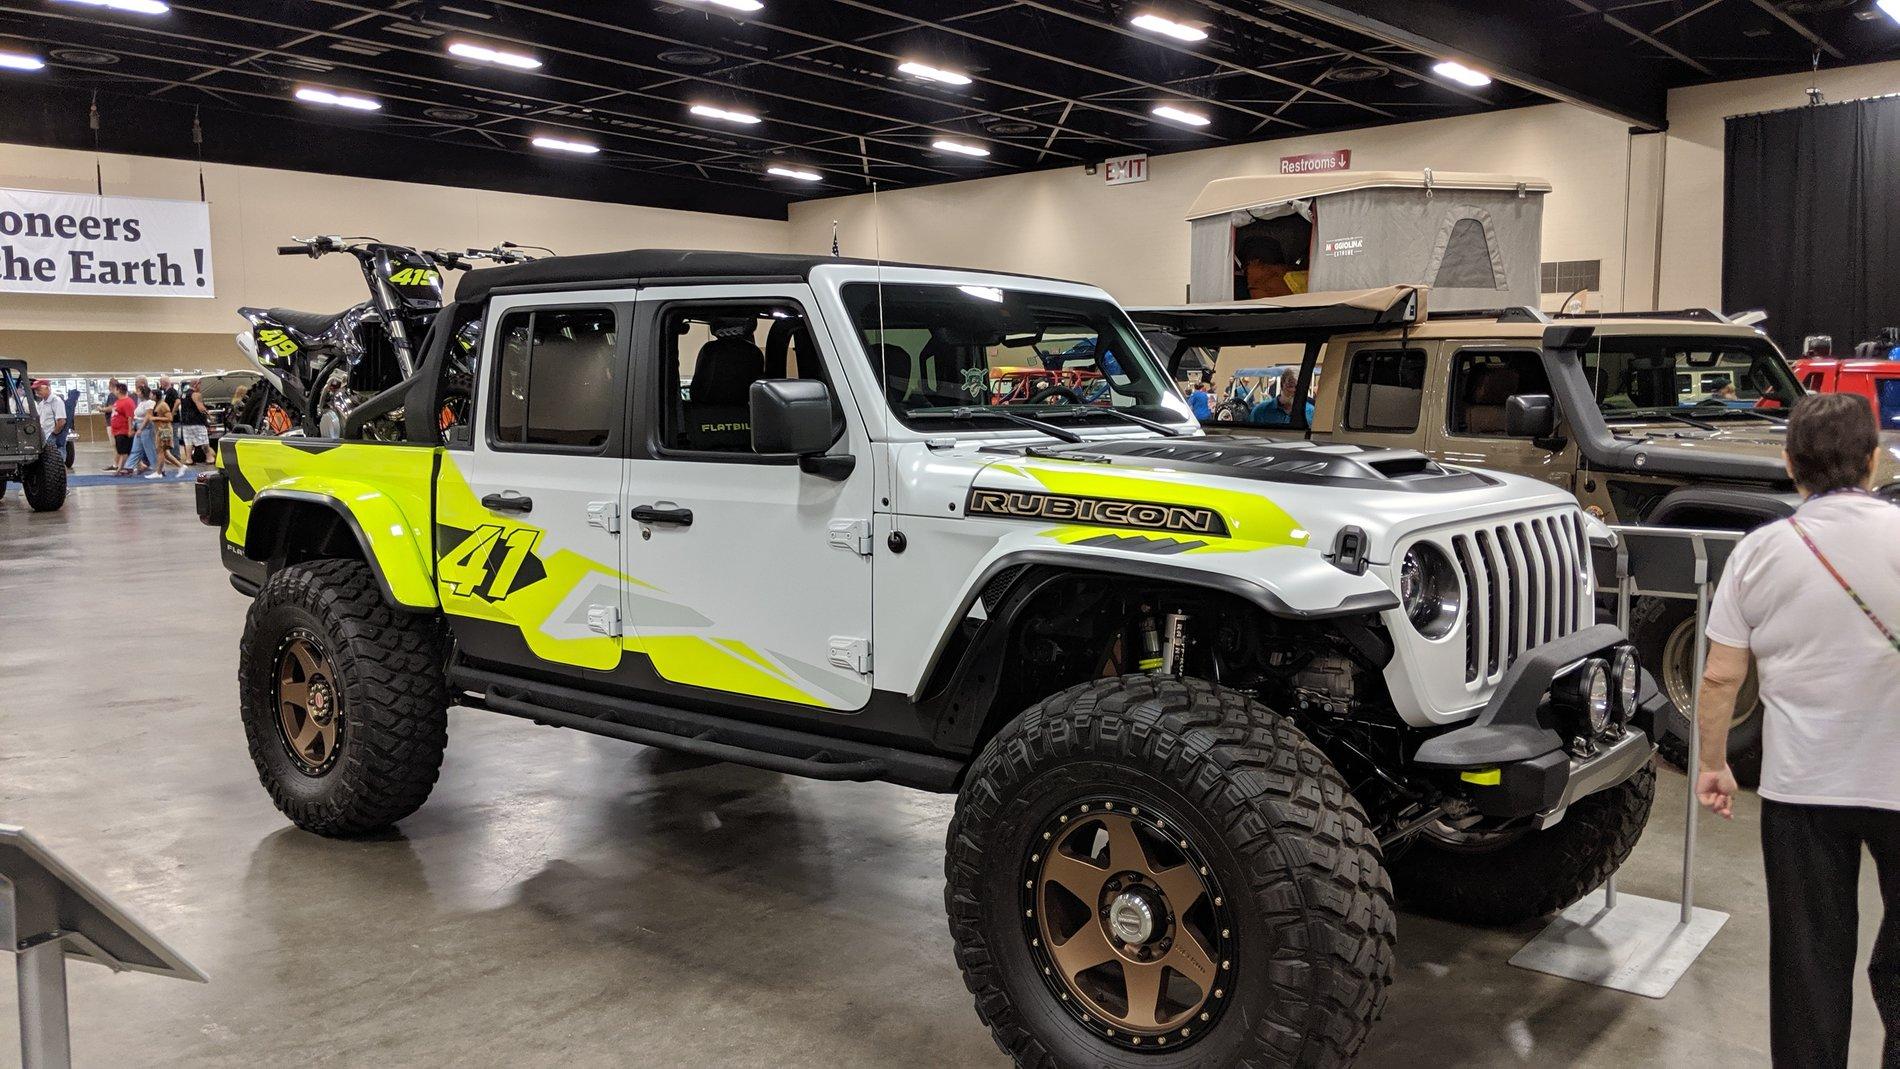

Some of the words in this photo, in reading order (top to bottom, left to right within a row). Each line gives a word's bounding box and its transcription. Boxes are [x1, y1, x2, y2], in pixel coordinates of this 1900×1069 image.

[1105, 158, 1146, 181] EXIT
[1281, 157, 1336, 173] Restrooms
[0, 210, 141, 242] oneers
[0, 245, 56, 283] he
[68, 250, 186, 286] Earth
[389, 268, 440, 286] 419
[259, 329, 299, 357] 419
[970, 490, 1212, 532] RUBICON
[437, 523, 541, 601] 41
